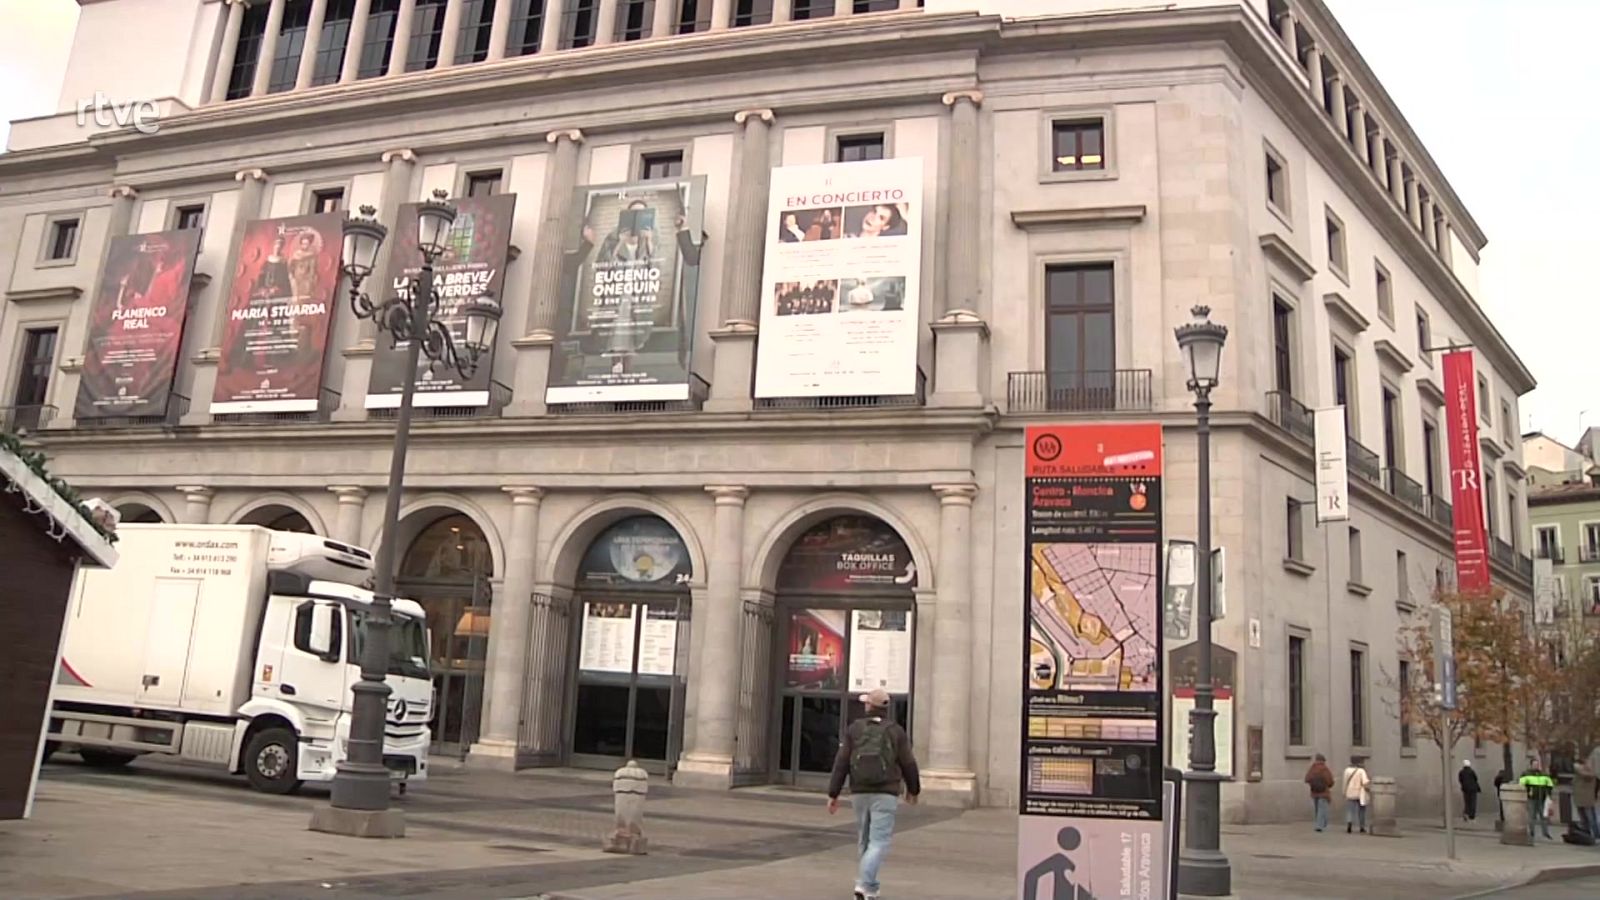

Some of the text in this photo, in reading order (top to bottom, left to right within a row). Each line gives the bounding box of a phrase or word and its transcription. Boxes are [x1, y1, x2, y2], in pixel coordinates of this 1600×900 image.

[786, 189, 904, 207] EN CONCIERTO
[595, 267, 660, 284] EUGENIO
[436, 283, 487, 298] VERDES
[592, 280, 660, 297] ONEGUIN
[111, 306, 167, 321] FLAMENCO
[232, 303, 326, 320] MARIA STUARDA
[122, 319, 150, 331] REAL
[1032, 465, 1115, 474] RUTA SALUDABLE
[1032, 485, 1065, 496] Centro
[842, 553, 896, 562] TAQUILLAS
[170, 566, 180, 574] Fax
[836, 561, 894, 571] BOX OFFICE
[1139, 832, 1151, 878] Aravaca
[1120, 831, 1132, 896] Saludable 17
